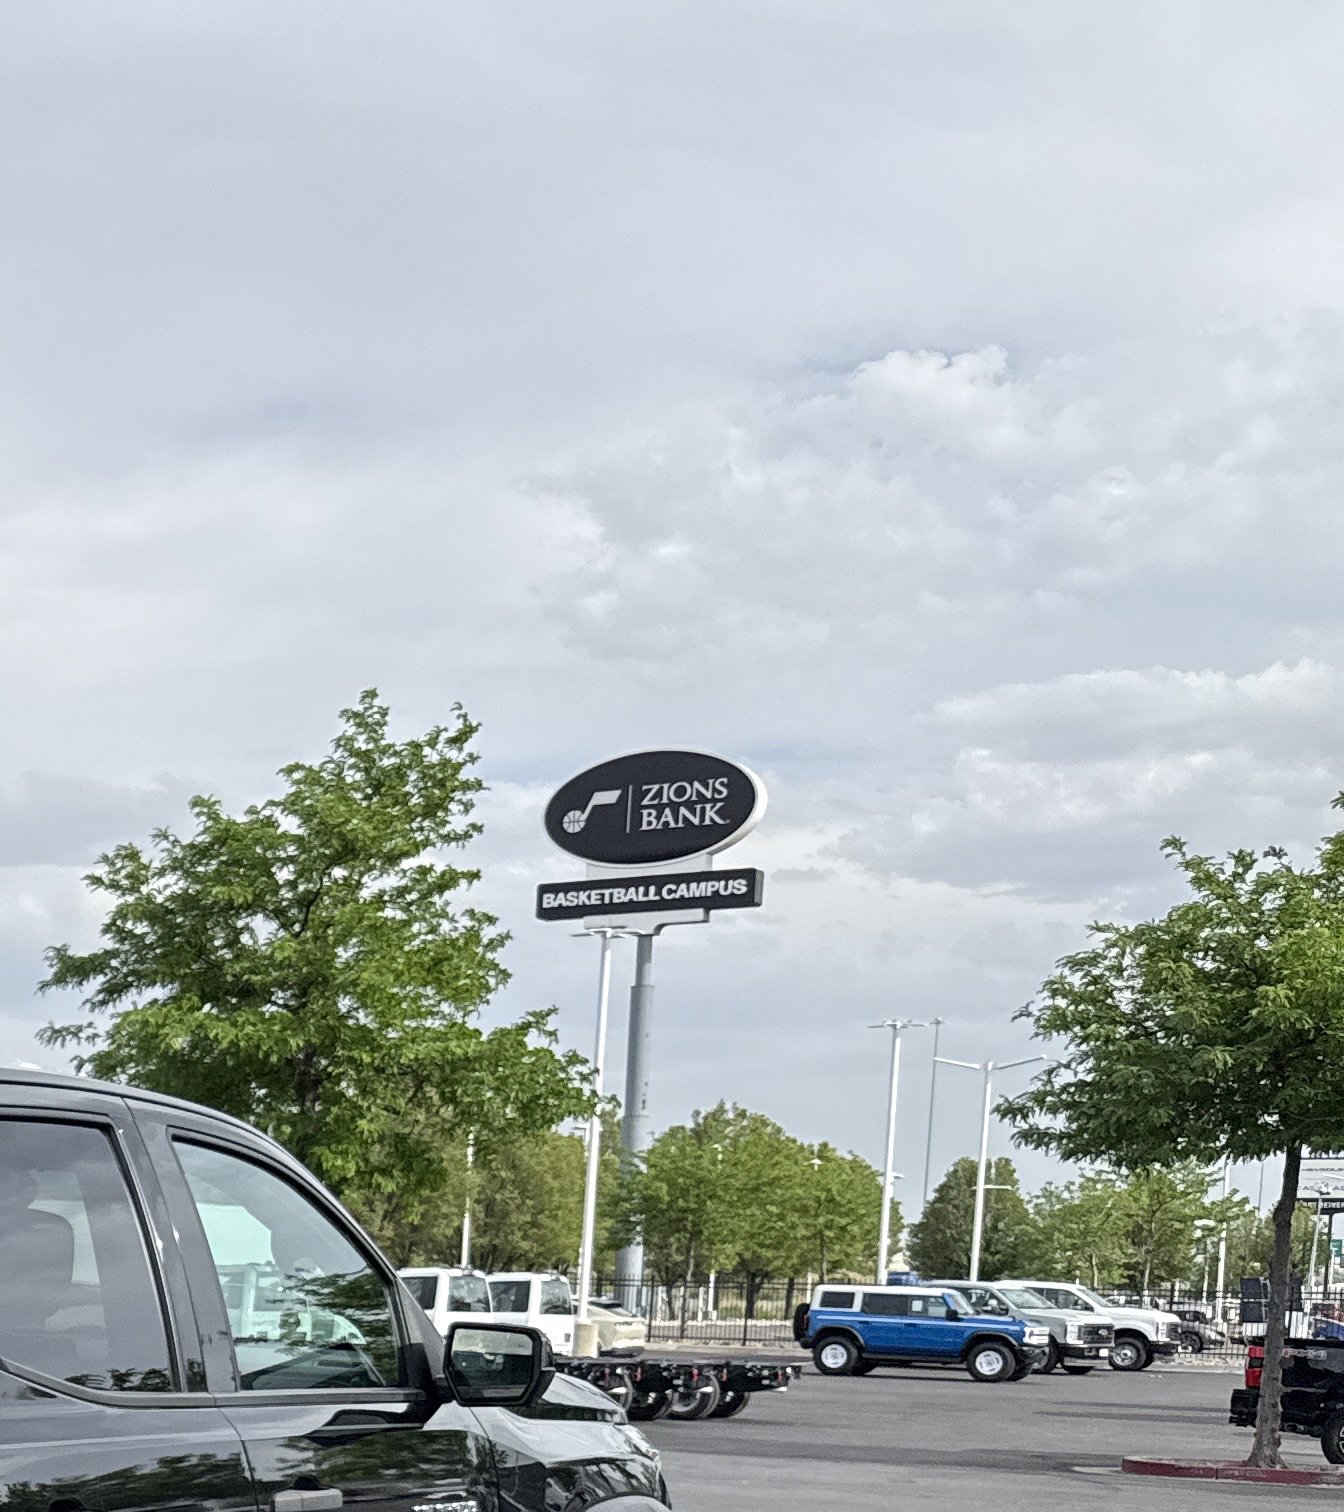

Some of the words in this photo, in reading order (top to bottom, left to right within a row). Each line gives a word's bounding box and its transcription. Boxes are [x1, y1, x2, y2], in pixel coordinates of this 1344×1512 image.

[640, 777, 729, 806] ZIONS
[638, 802, 727, 831] BANK
[542, 885, 659, 909] BASKETBALL
[662, 878, 748, 899] CAMPUS
